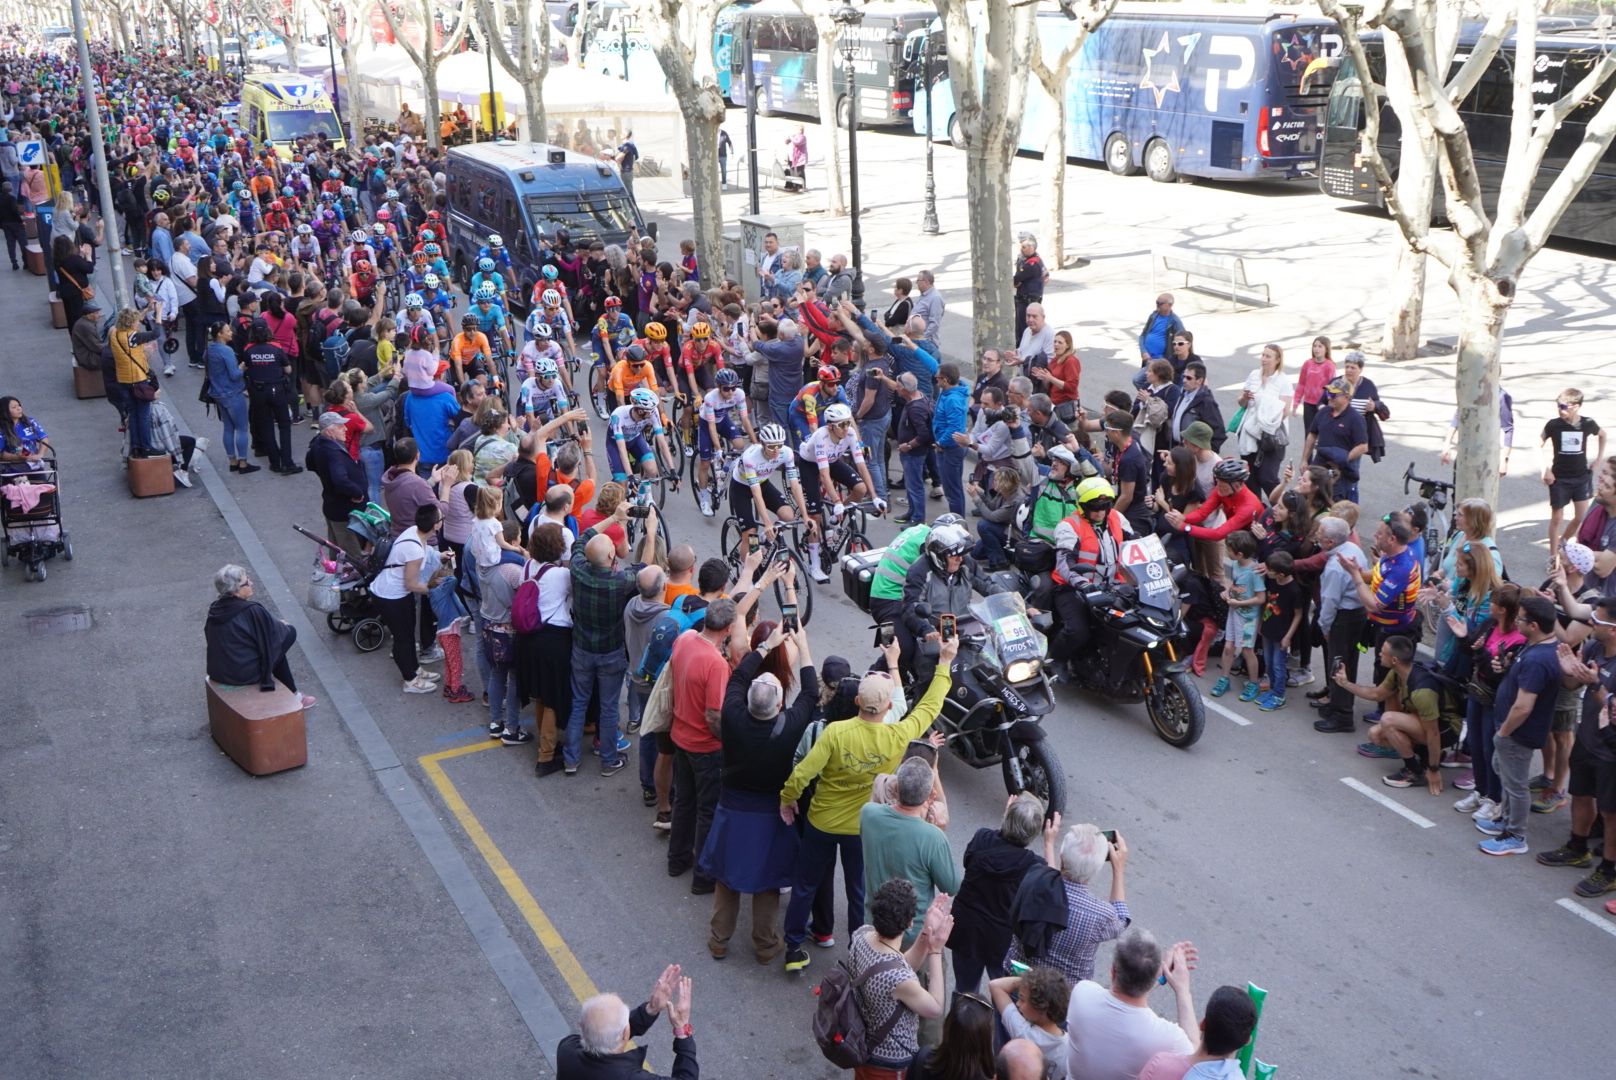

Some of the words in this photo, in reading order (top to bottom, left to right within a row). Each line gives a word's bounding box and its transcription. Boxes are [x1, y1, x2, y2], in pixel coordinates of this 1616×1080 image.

[1283, 121, 1305, 129] FACTOR
[1128, 543, 1149, 565] A
[1013, 626, 1026, 637] 96
